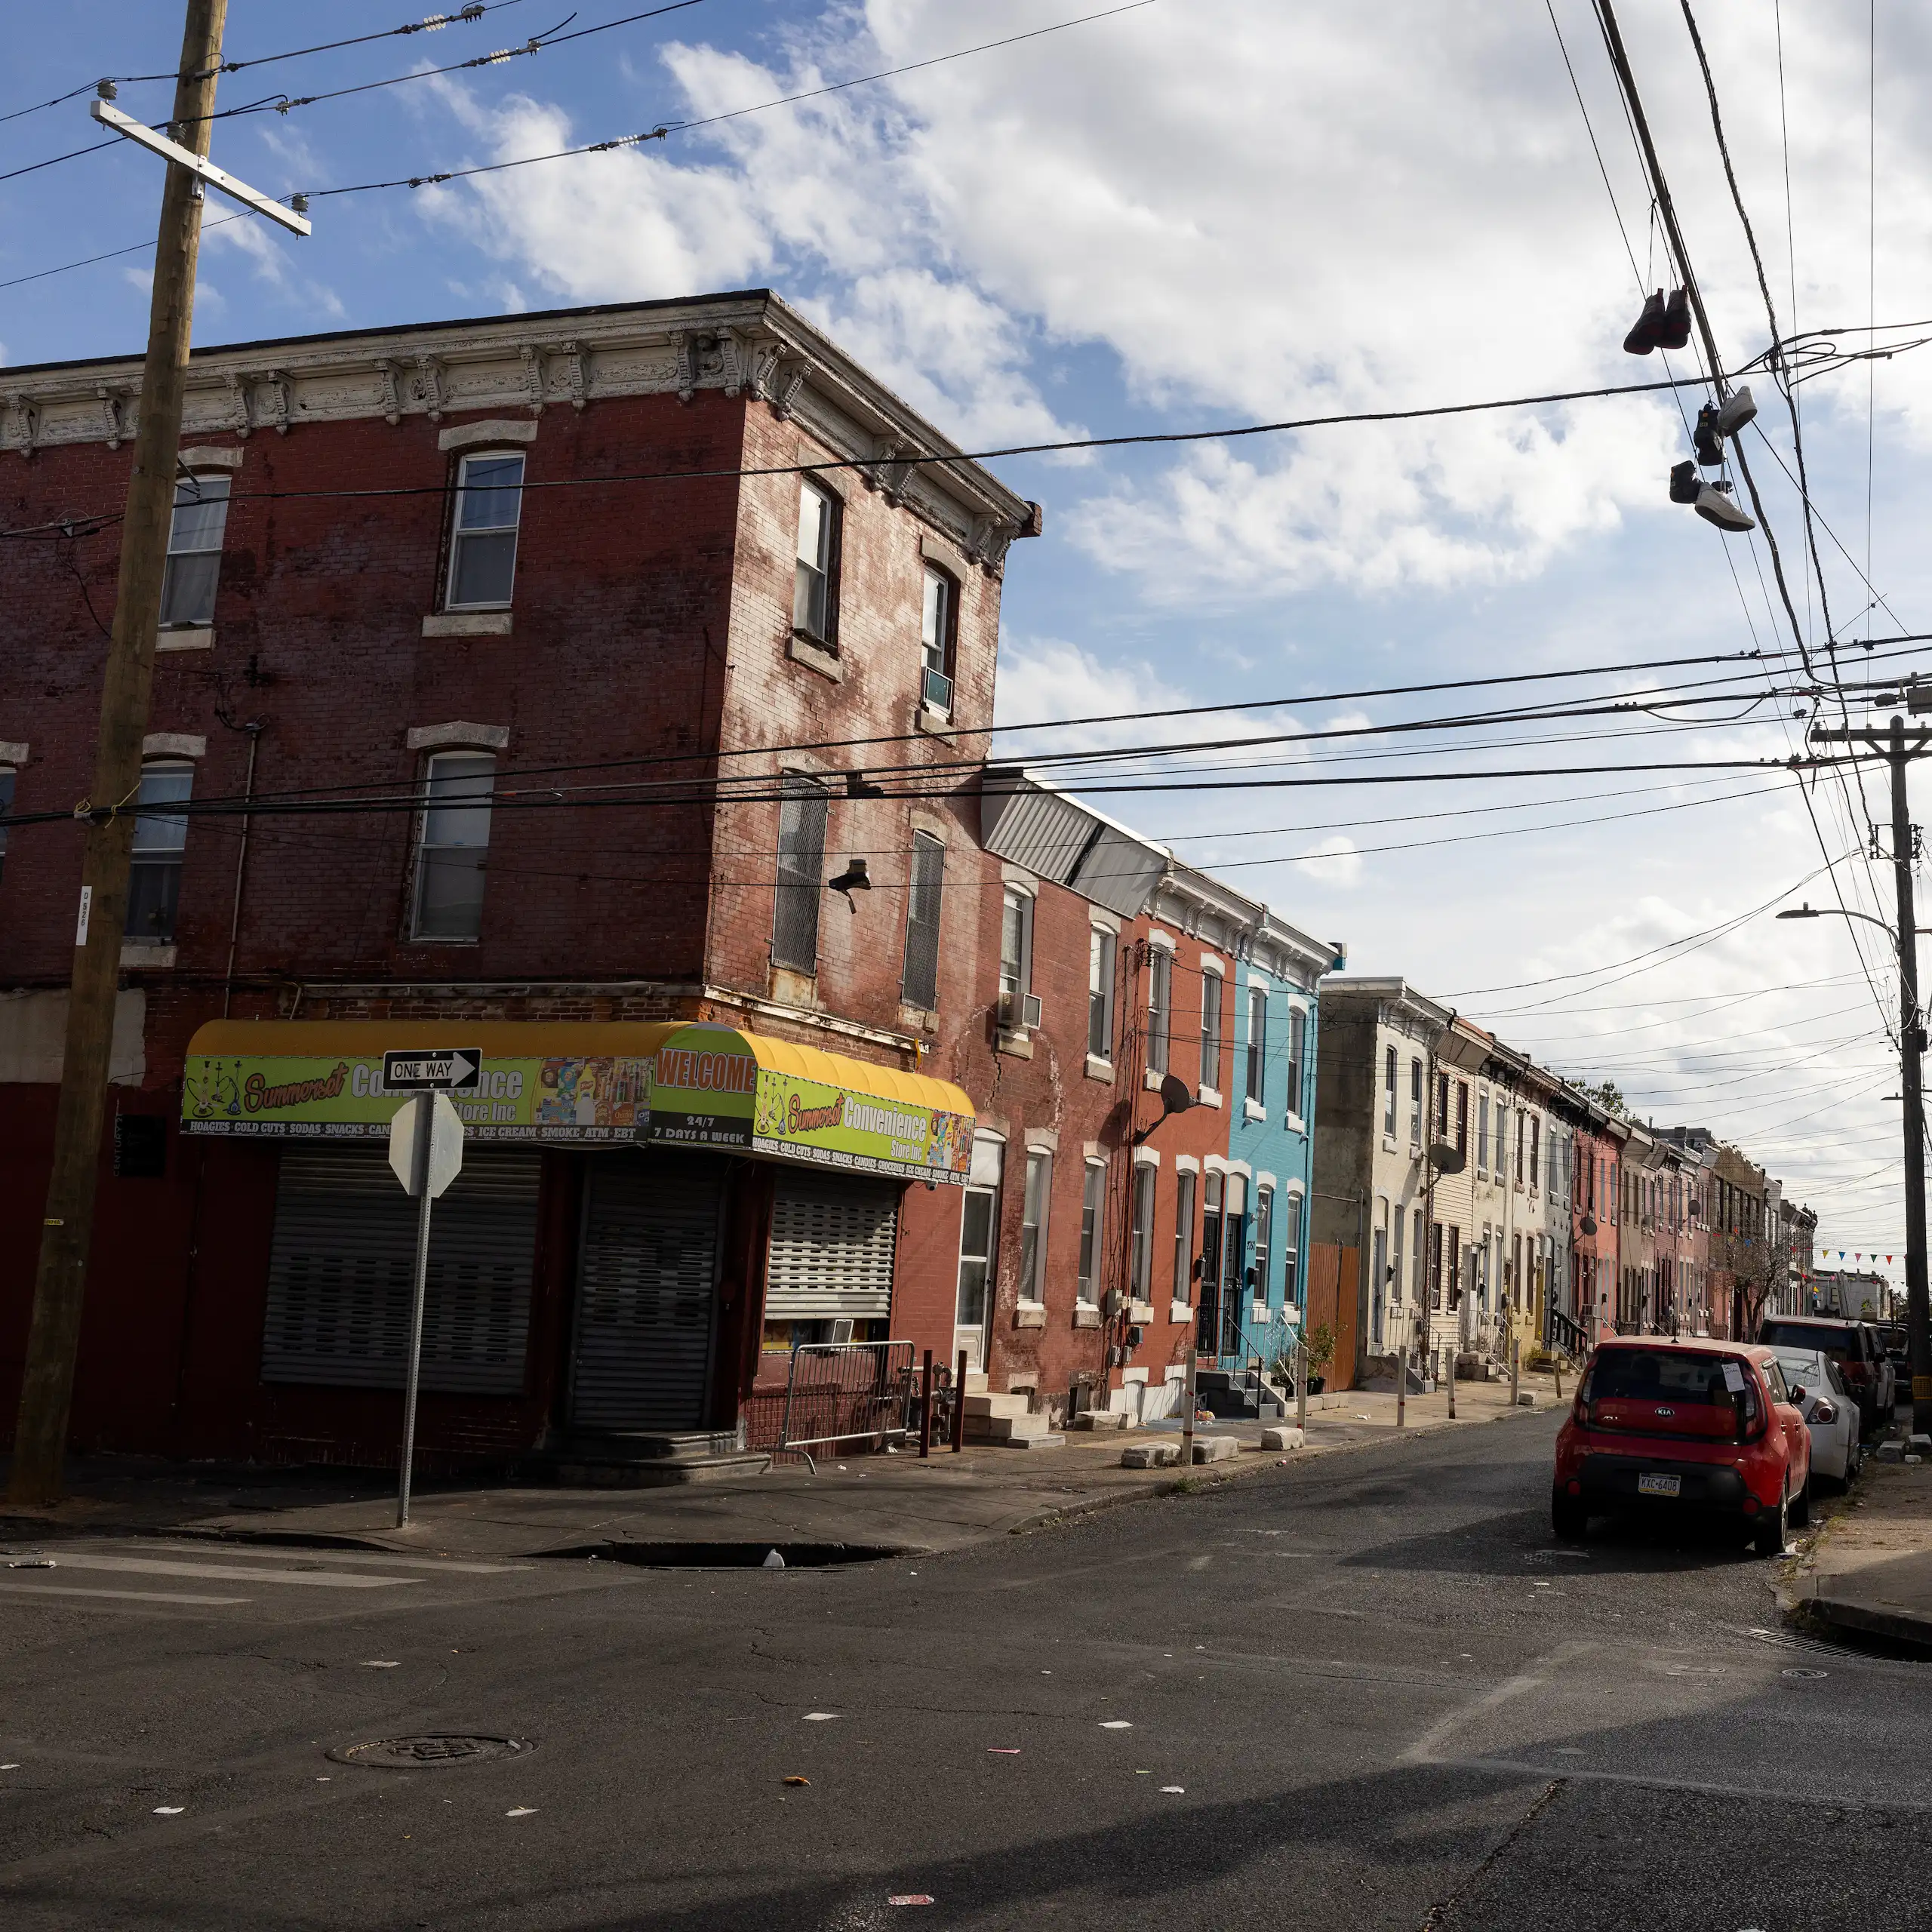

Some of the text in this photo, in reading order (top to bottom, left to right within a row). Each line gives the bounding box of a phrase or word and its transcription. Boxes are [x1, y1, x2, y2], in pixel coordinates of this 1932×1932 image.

[394, 1062, 453, 1078] ONE WAY
[654, 1047, 757, 1095] WELCOME
[244, 1061, 349, 1113] Summerset
[491, 1101, 516, 1122] Inc
[686, 1115, 715, 1128] 24/7
[788, 1092, 927, 1142] Summerset Convenience
[190, 1121, 231, 1132] HOAGIES
[234, 1121, 259, 1132] COLD
[260, 1122, 285, 1133] CUTS
[289, 1123, 321, 1134] SODAS
[325, 1124, 365, 1134] SNACKS
[478, 1126, 496, 1137] ICE
[497, 1127, 537, 1137] CREAM
[540, 1126, 580, 1138] SMOKE
[583, 1127, 610, 1138] ATM
[613, 1128, 636, 1139] EBT
[654, 1128, 745, 1143] 7 DAYS A WEEK
[112, 1125, 124, 1177] CENTURY
[752, 1137, 779, 1151] HOAGIES
[780, 1142, 795, 1154] COLD
[796, 1145, 811, 1157] CUTS
[813, 1148, 831, 1161] SODAS
[832, 1152, 853, 1164] SNACKS
[854, 1155, 877, 1168] CANDIES
[878, 1159, 905, 1174] GROCERIES
[915, 1166, 931, 1177] CREAM
[932, 1169, 949, 1180] SMOKE
[949, 1172, 960, 1181] ATM
[891, 1139, 922, 1161] Store Inc
